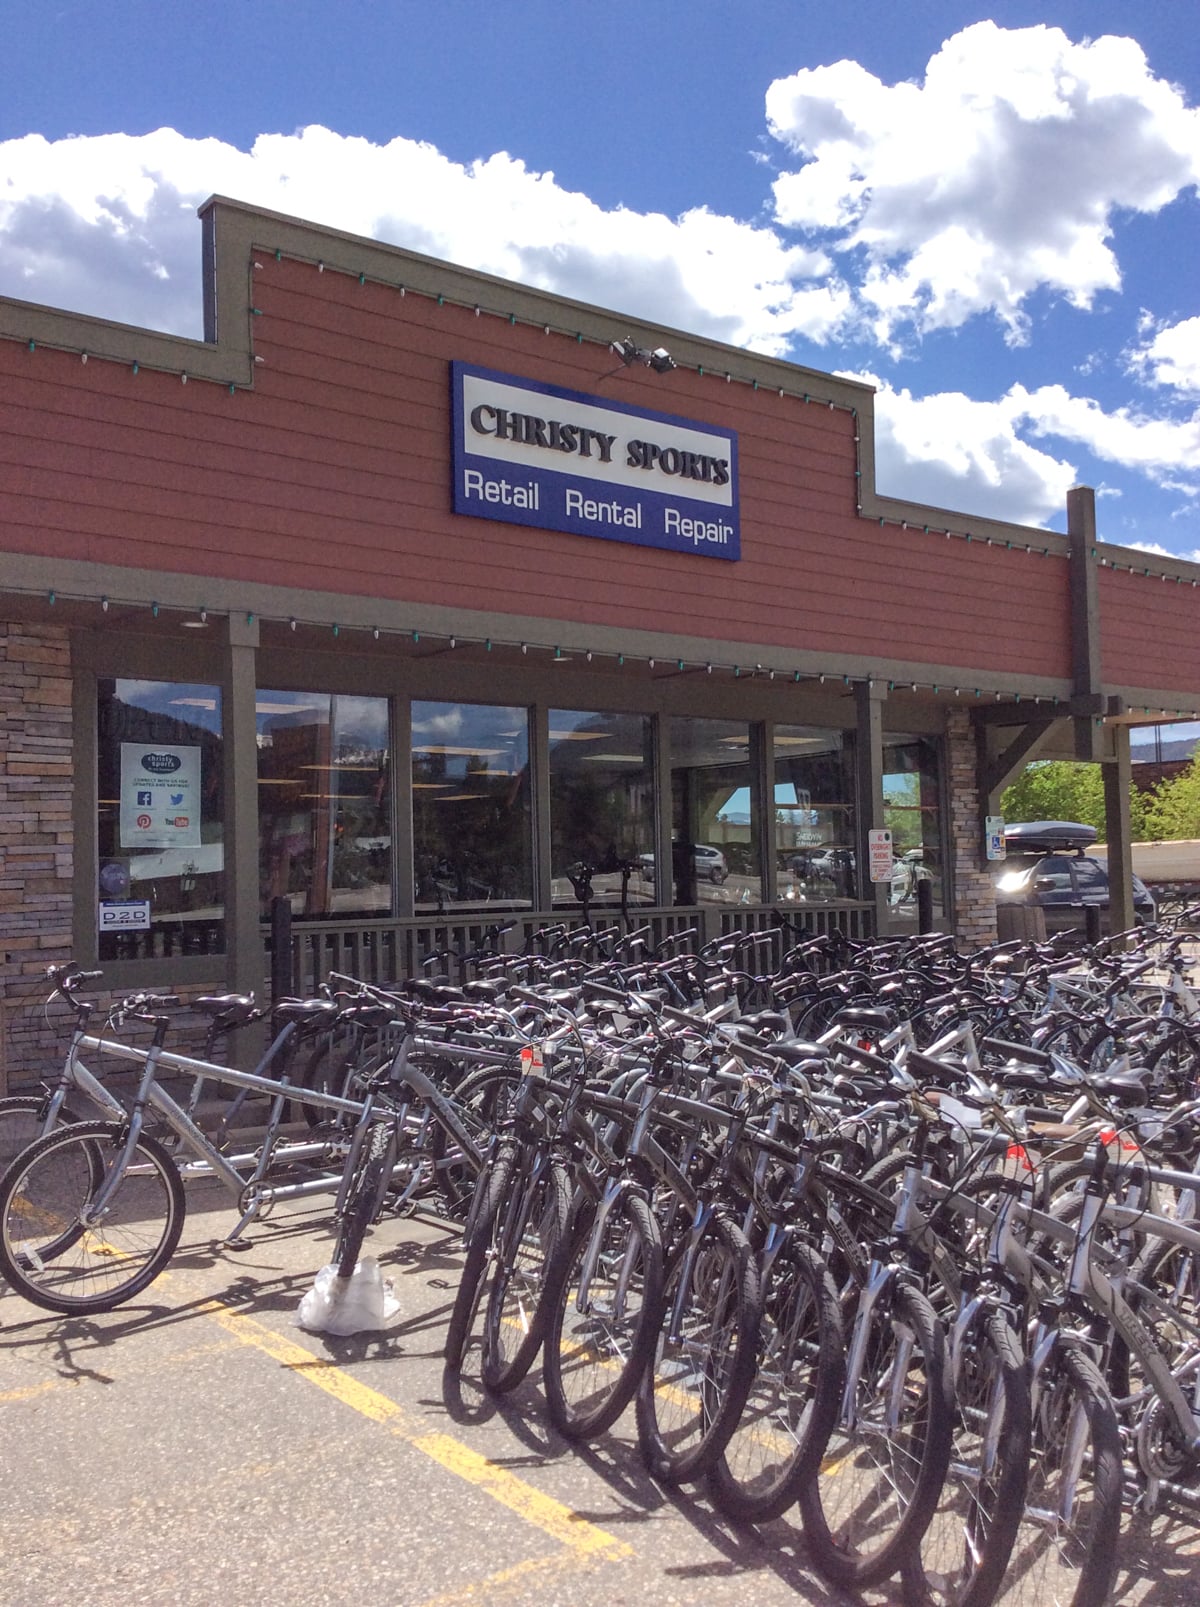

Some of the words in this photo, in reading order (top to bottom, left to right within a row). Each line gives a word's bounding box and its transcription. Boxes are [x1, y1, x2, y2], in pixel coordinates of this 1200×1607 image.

[470, 404, 617, 463] CHRISTY
[626, 439, 730, 486] SPORTS
[463, 469, 539, 511] Retail
[565, 488, 642, 529] Rental
[664, 508, 733, 546] Repair
[104, 911, 146, 920] D2D
